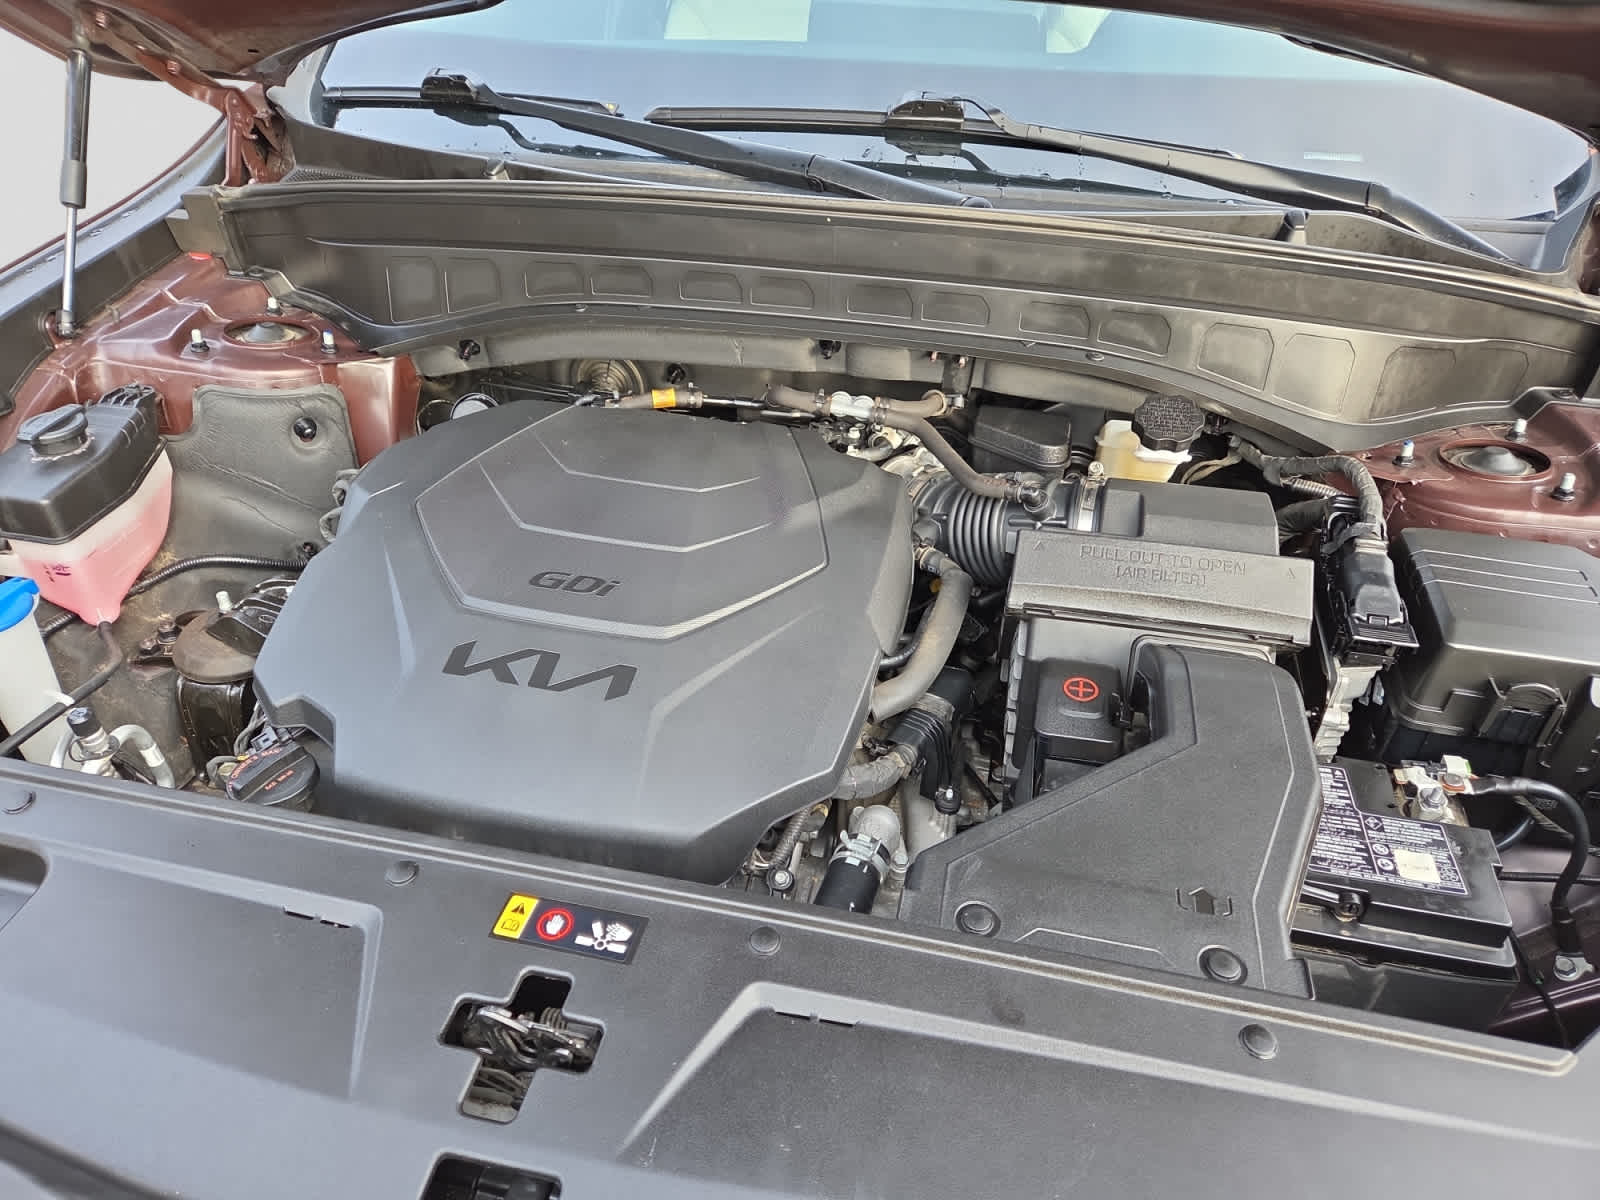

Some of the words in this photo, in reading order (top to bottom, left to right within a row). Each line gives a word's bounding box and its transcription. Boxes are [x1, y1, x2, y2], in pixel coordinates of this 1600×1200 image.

[1080, 544, 1125, 562] PULL
[1129, 550, 1165, 565] OUT
[1170, 554, 1193, 569] TO
[1198, 558, 1246, 576] OPEN
[528, 571, 621, 597] GDi
[442, 640, 638, 701] KIA
